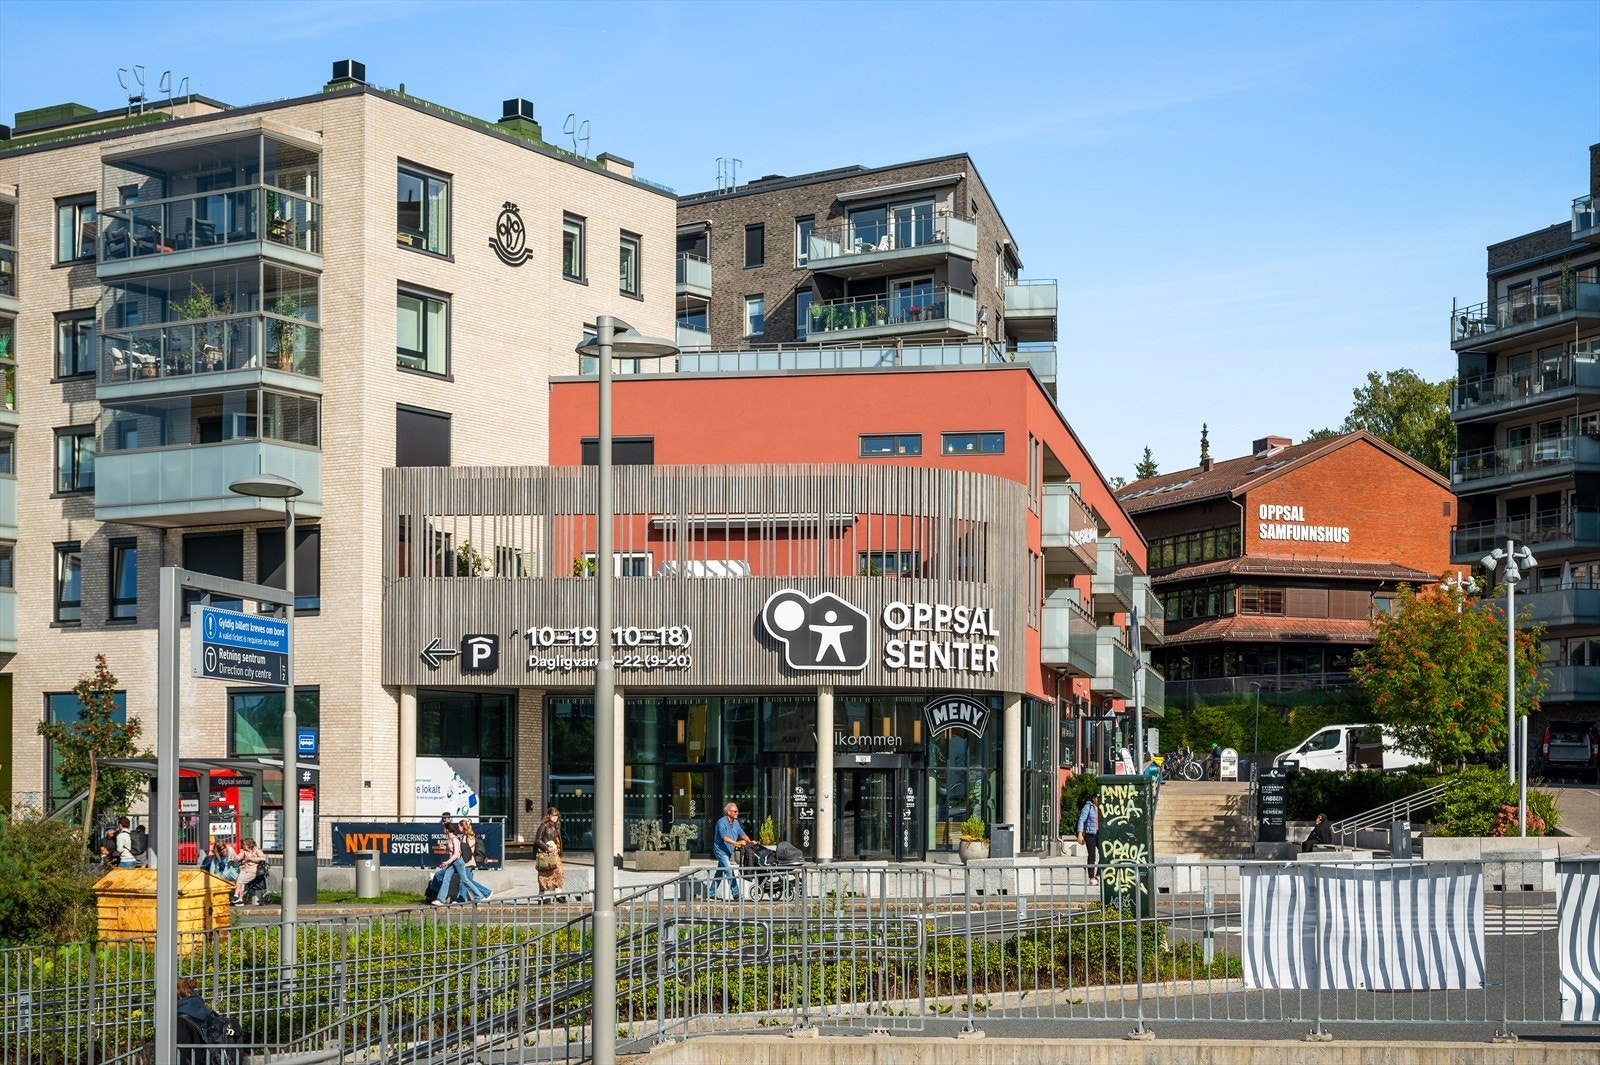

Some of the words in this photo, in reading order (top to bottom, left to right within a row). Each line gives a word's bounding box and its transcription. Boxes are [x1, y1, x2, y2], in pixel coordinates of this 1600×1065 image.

[1259, 504, 1305, 521] OPPSAL
[1260, 524, 1350, 543] SAMFUNNSHUS
[219, 618, 234, 630] Gyldig
[235, 621, 249, 631] billett
[250, 623, 265, 633] kreves
[274, 627, 284, 636] bord
[883, 601, 999, 636] OPPSAL
[247, 636, 262, 645] required
[612, 625, 692, 648] 10–18)
[219, 648, 241, 663] Retning
[242, 652, 266, 664] sentrum
[472, 644, 490, 667] P
[885, 640, 999, 672] SENTER
[219, 663, 244, 676] Direction
[245, 666, 254, 679] city
[255, 669, 271, 679] centre
[282, 673, 286, 681] 2
[933, 703, 983, 726] MENY
[813, 731, 902, 746] Vlkommen
[422, 785, 440, 793] lokalt
[346, 834, 390, 853] NYTT
[392, 843, 429, 854] SYSTEM
